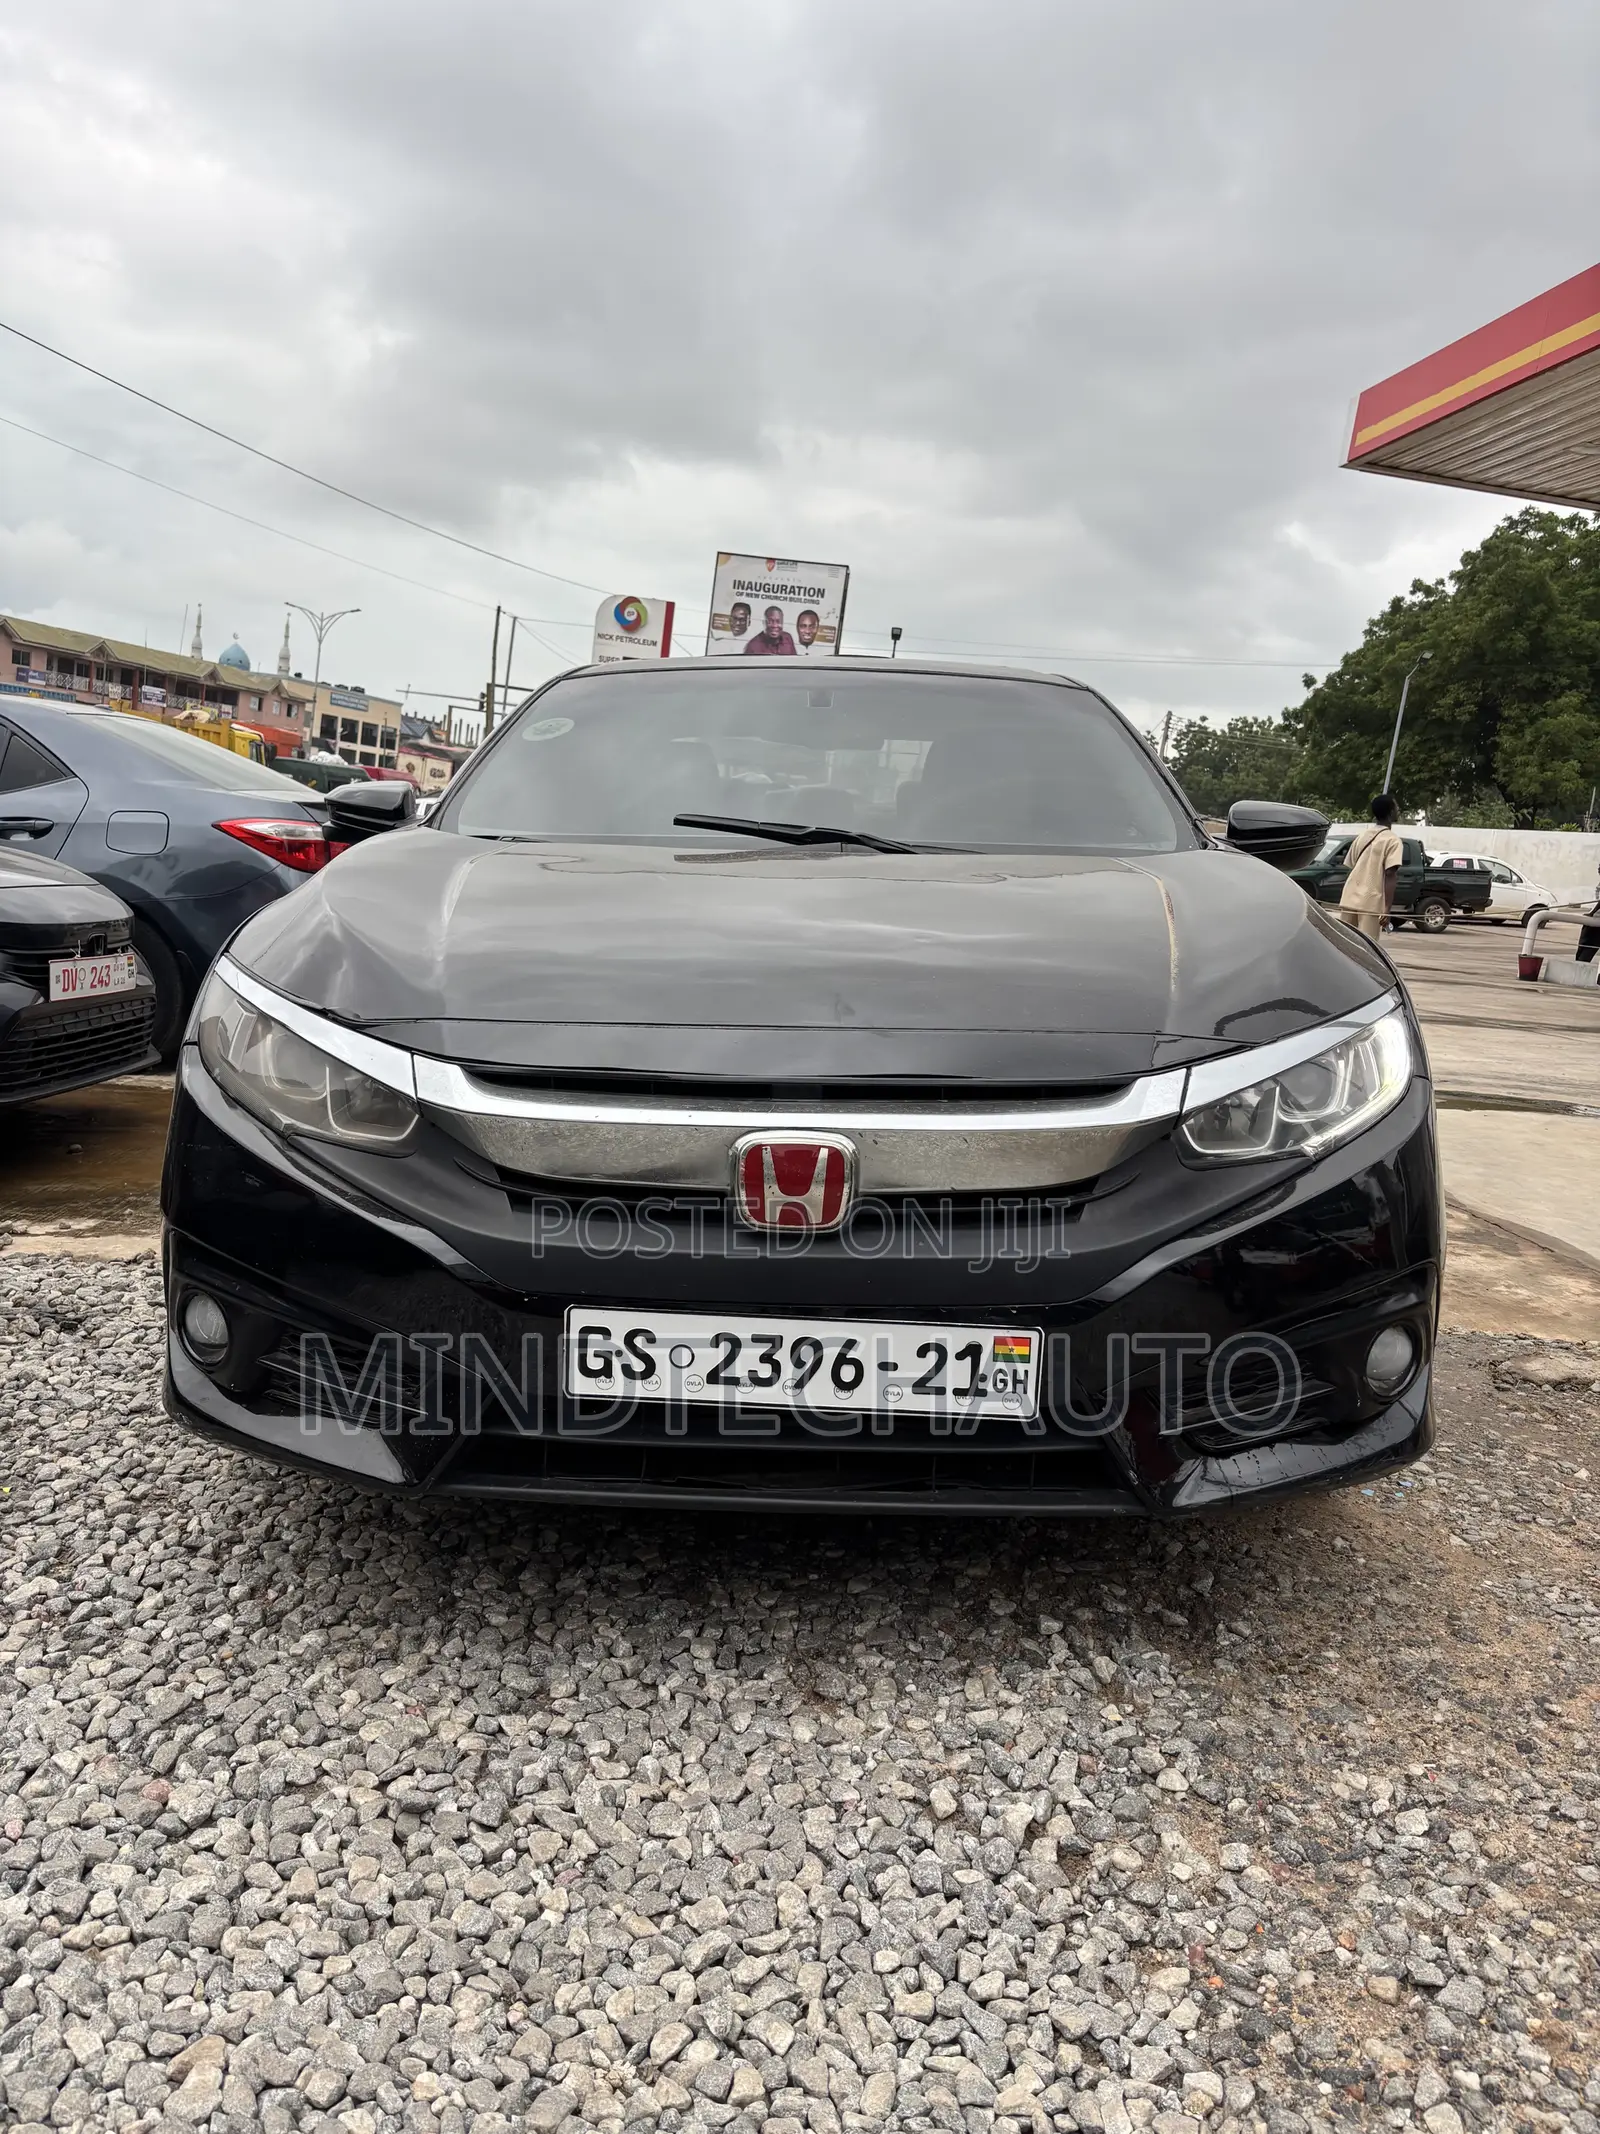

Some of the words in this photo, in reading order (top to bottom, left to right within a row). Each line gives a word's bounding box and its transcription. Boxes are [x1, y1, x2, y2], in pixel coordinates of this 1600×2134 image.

[732, 579, 826, 599] INAUGURATION
[761, 593, 788, 602] CHURCH
[788, 595, 820, 605] BUILDING
[597, 633, 614, 641] NICK
[615, 634, 658, 647] PETROLEUM
[61, 967, 78, 993] DV
[89, 964, 111, 989] 243
[577, 1325, 657, 1381] GS
[992, 1368, 1029, 1395] GH
